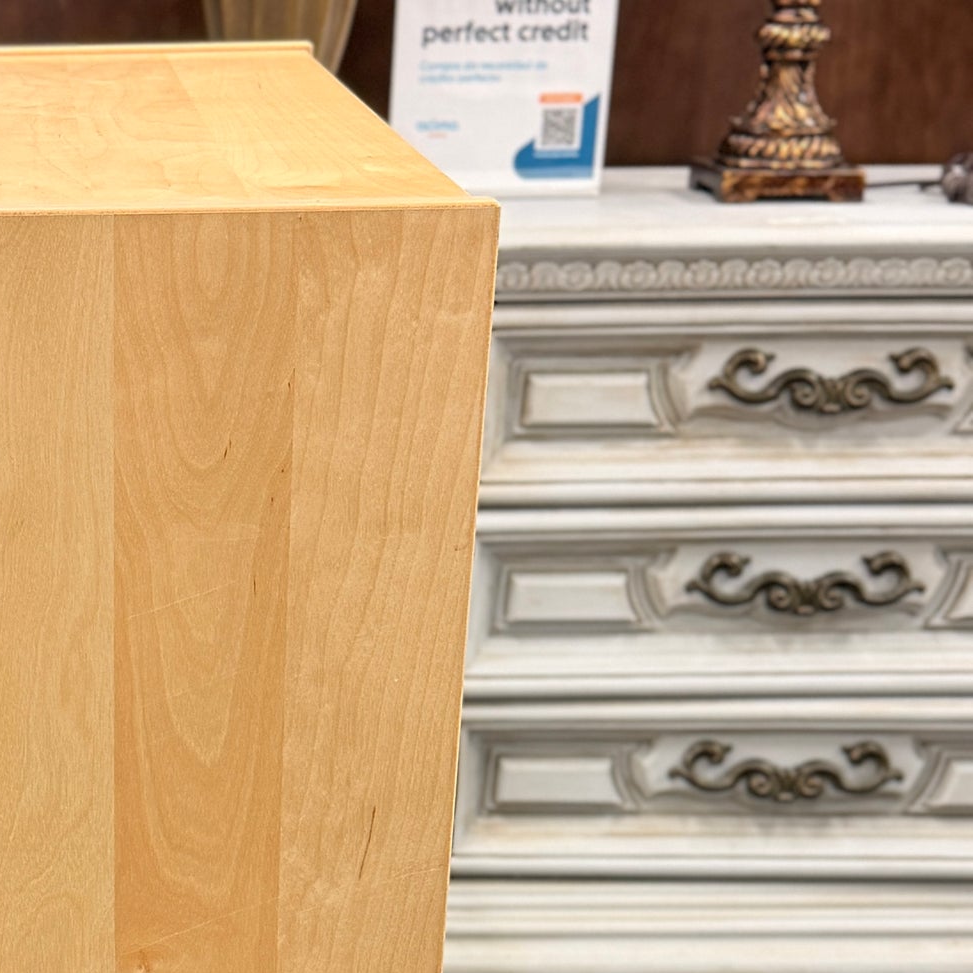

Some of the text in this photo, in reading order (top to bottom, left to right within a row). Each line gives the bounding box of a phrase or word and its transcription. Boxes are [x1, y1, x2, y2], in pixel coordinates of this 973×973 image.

[497, 0, 590, 14] without
[422, 19, 588, 48] perfect credit
